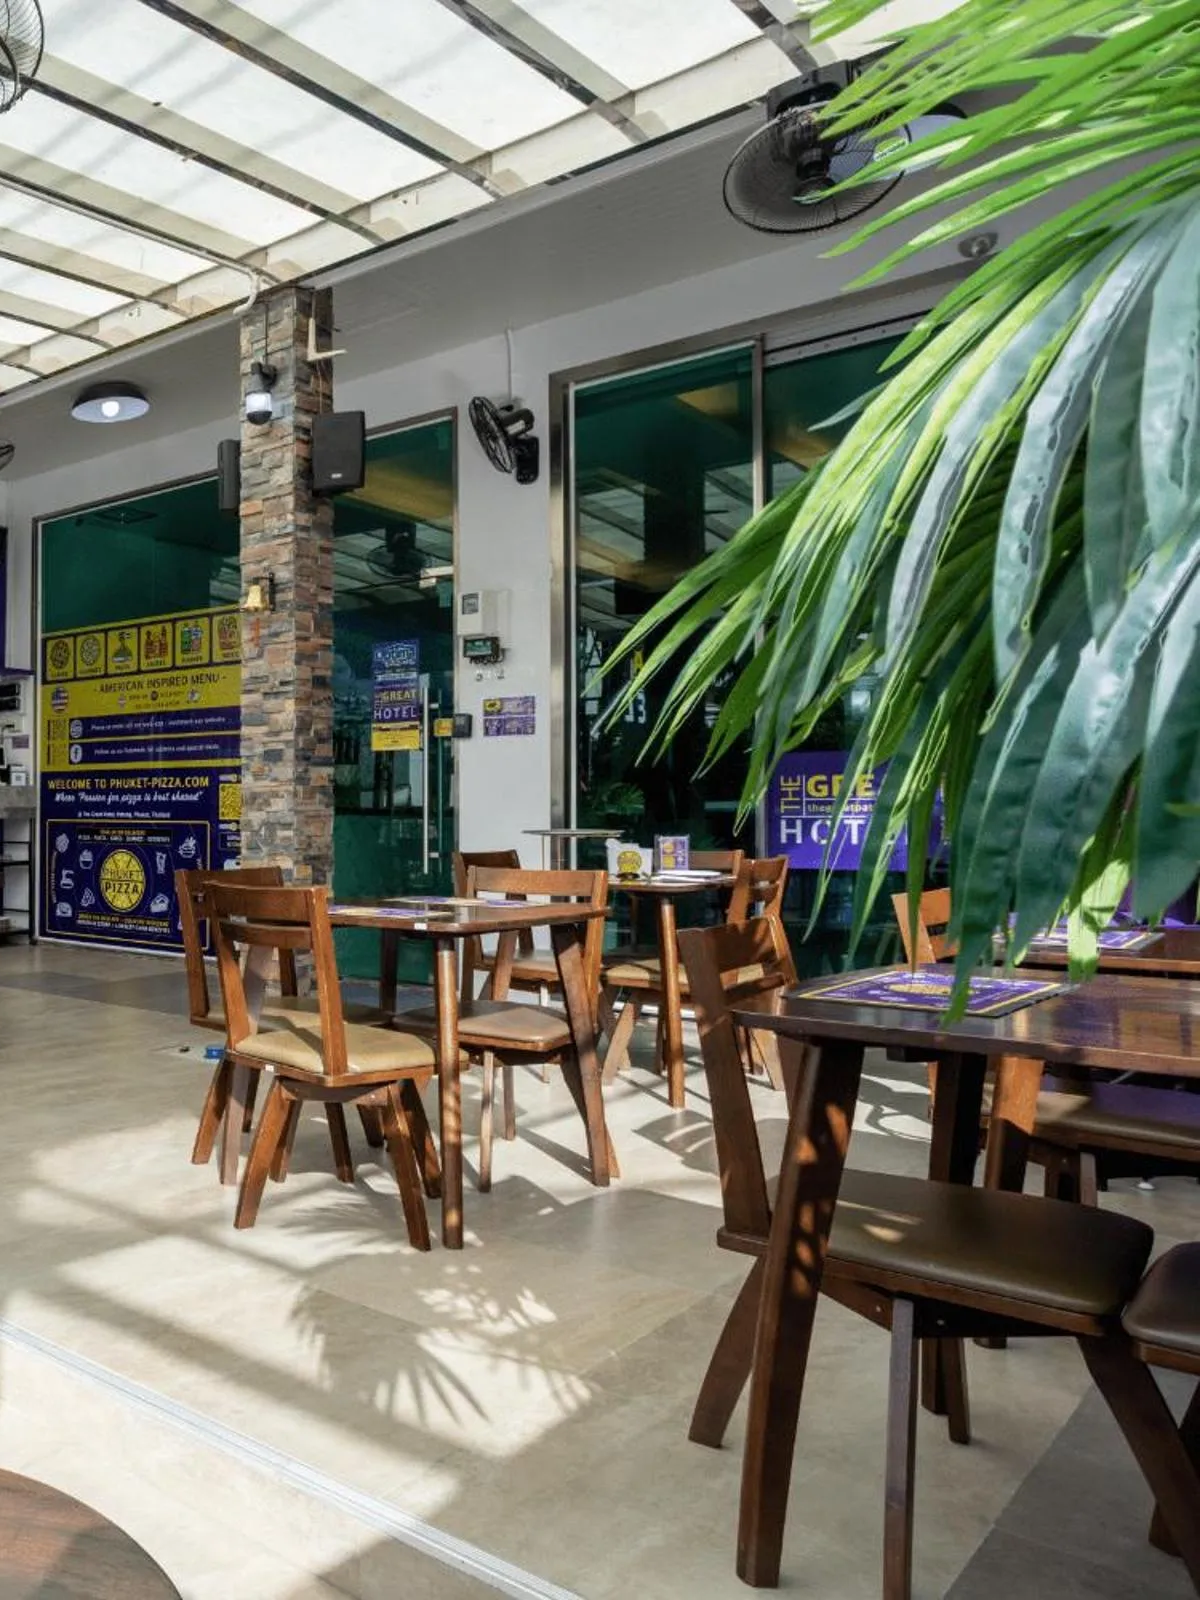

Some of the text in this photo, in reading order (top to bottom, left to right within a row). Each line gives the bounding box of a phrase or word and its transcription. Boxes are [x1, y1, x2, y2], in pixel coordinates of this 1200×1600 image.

[100, 673, 219, 692] AMERICAN INSPIRED MENU
[374, 706, 417, 720] HOTEL
[48, 776, 209, 790] WELCOME TO PHUKET-PIZZA.COM
[780, 775, 800, 814] THE
[780, 819, 866, 845] HOT
[105, 881, 140, 894] PIZZA
